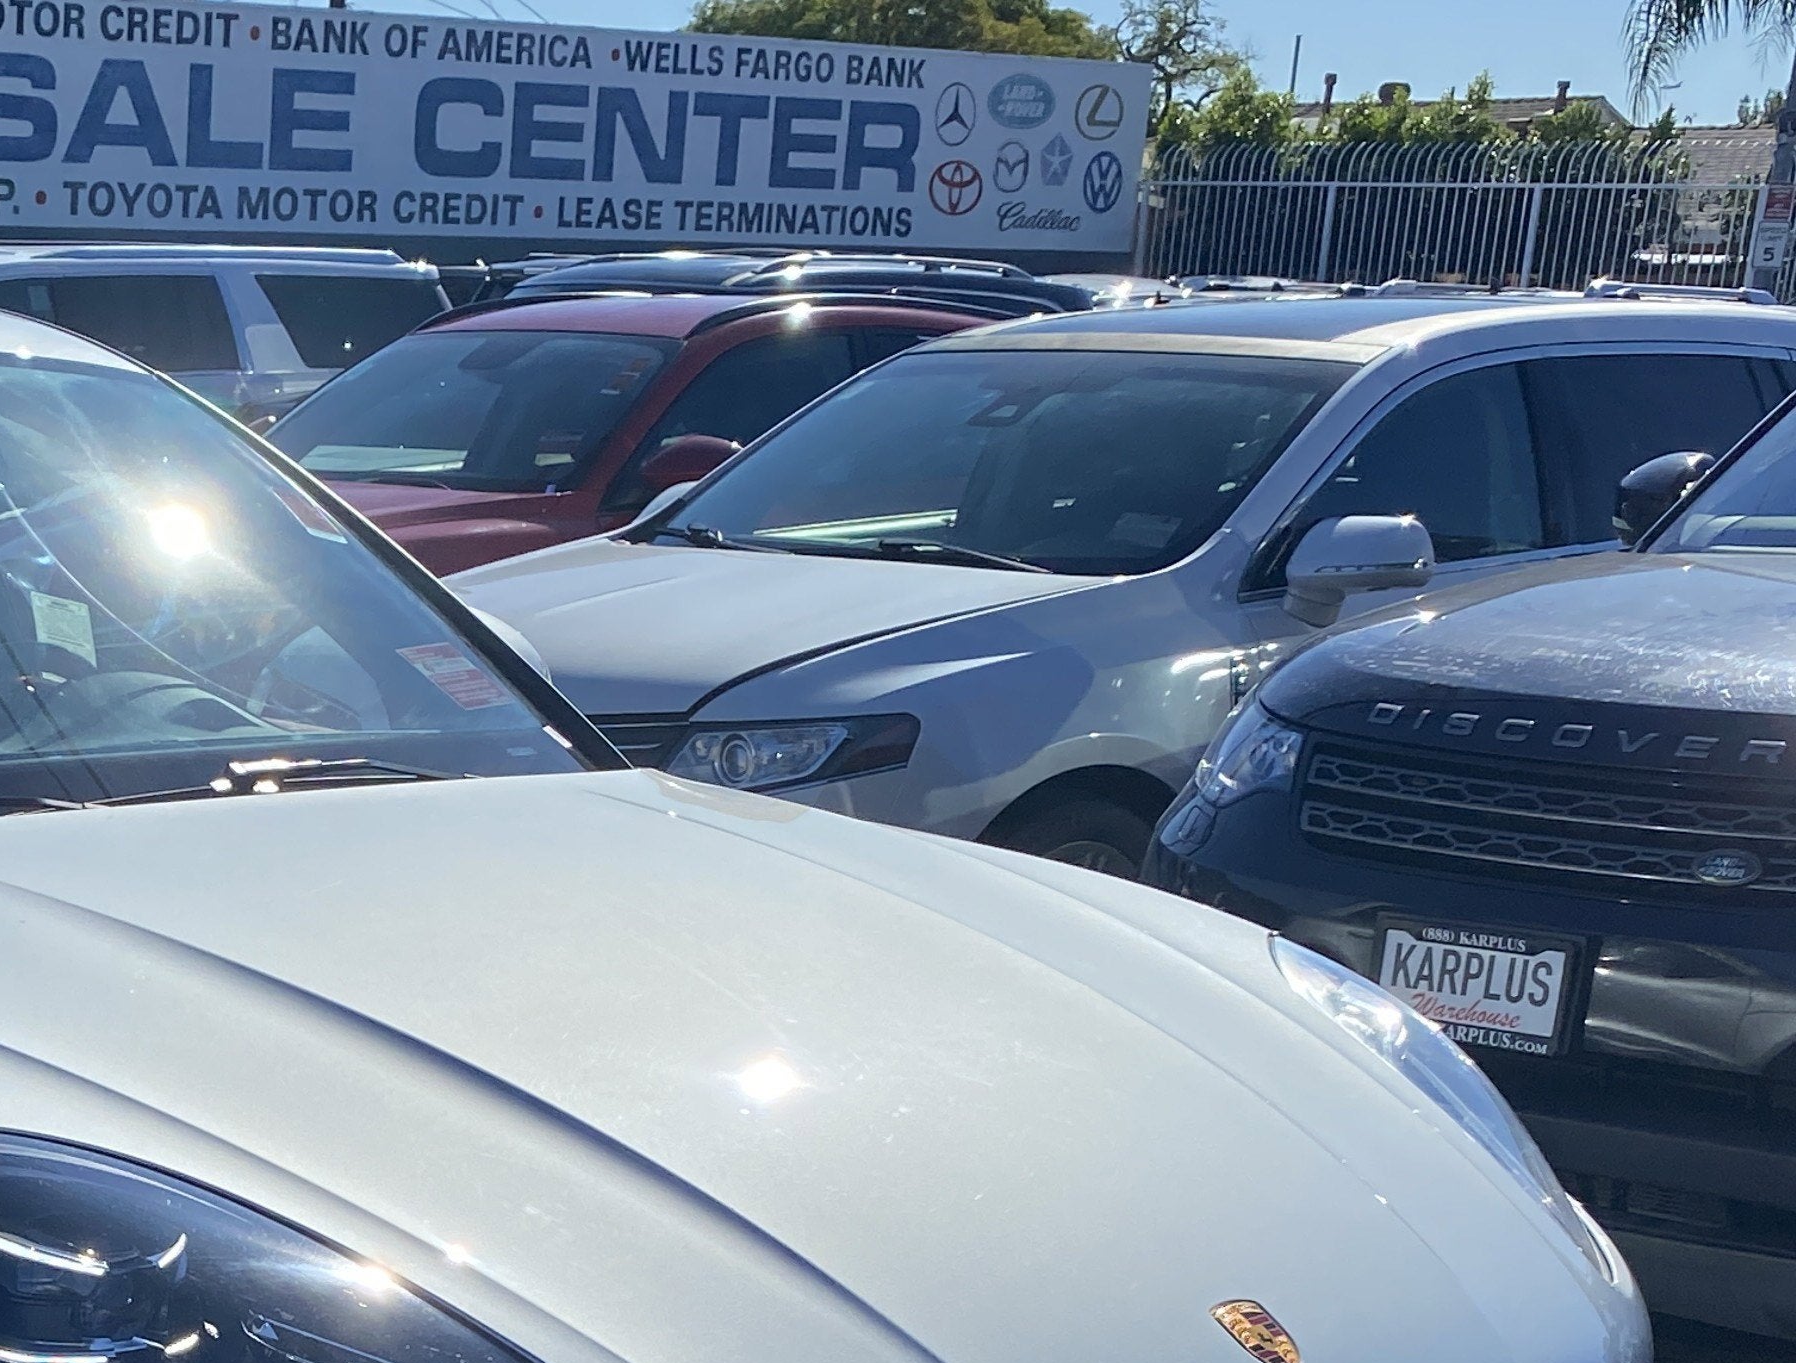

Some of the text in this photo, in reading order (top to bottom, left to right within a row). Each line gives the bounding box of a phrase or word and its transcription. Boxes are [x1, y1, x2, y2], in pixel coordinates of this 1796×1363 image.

[100, 3, 237, 49] CREDIT
[271, 16, 369, 57] BANK
[383, 24, 428, 61] OF
[438, 29, 593, 70] AMERICA
[624, 39, 724, 79] WELLS
[735, 48, 835, 85] FARGO
[846, 54, 926, 90] BANK
[414, 77, 921, 193] CENTER
[62, 180, 222, 221] TOYOTA
[236, 187, 378, 224] MOTOR
[393, 192, 523, 227] CREDIT
[557, 196, 661, 233] LEASE
[674, 199, 912, 238] TERMINATIONS
[996, 200, 1082, 232] Cadillac
[1763, 247, 1775, 262] 5
[1367, 702, 1787, 764] DISCOVER
[1422, 927, 1527, 952] (888) KARPLUS
[1391, 942, 1553, 1007] KARPLUS
[1411, 993, 1521, 1029] Warehouse
[1442, 1024, 1548, 1055] ARPLUS.COM
